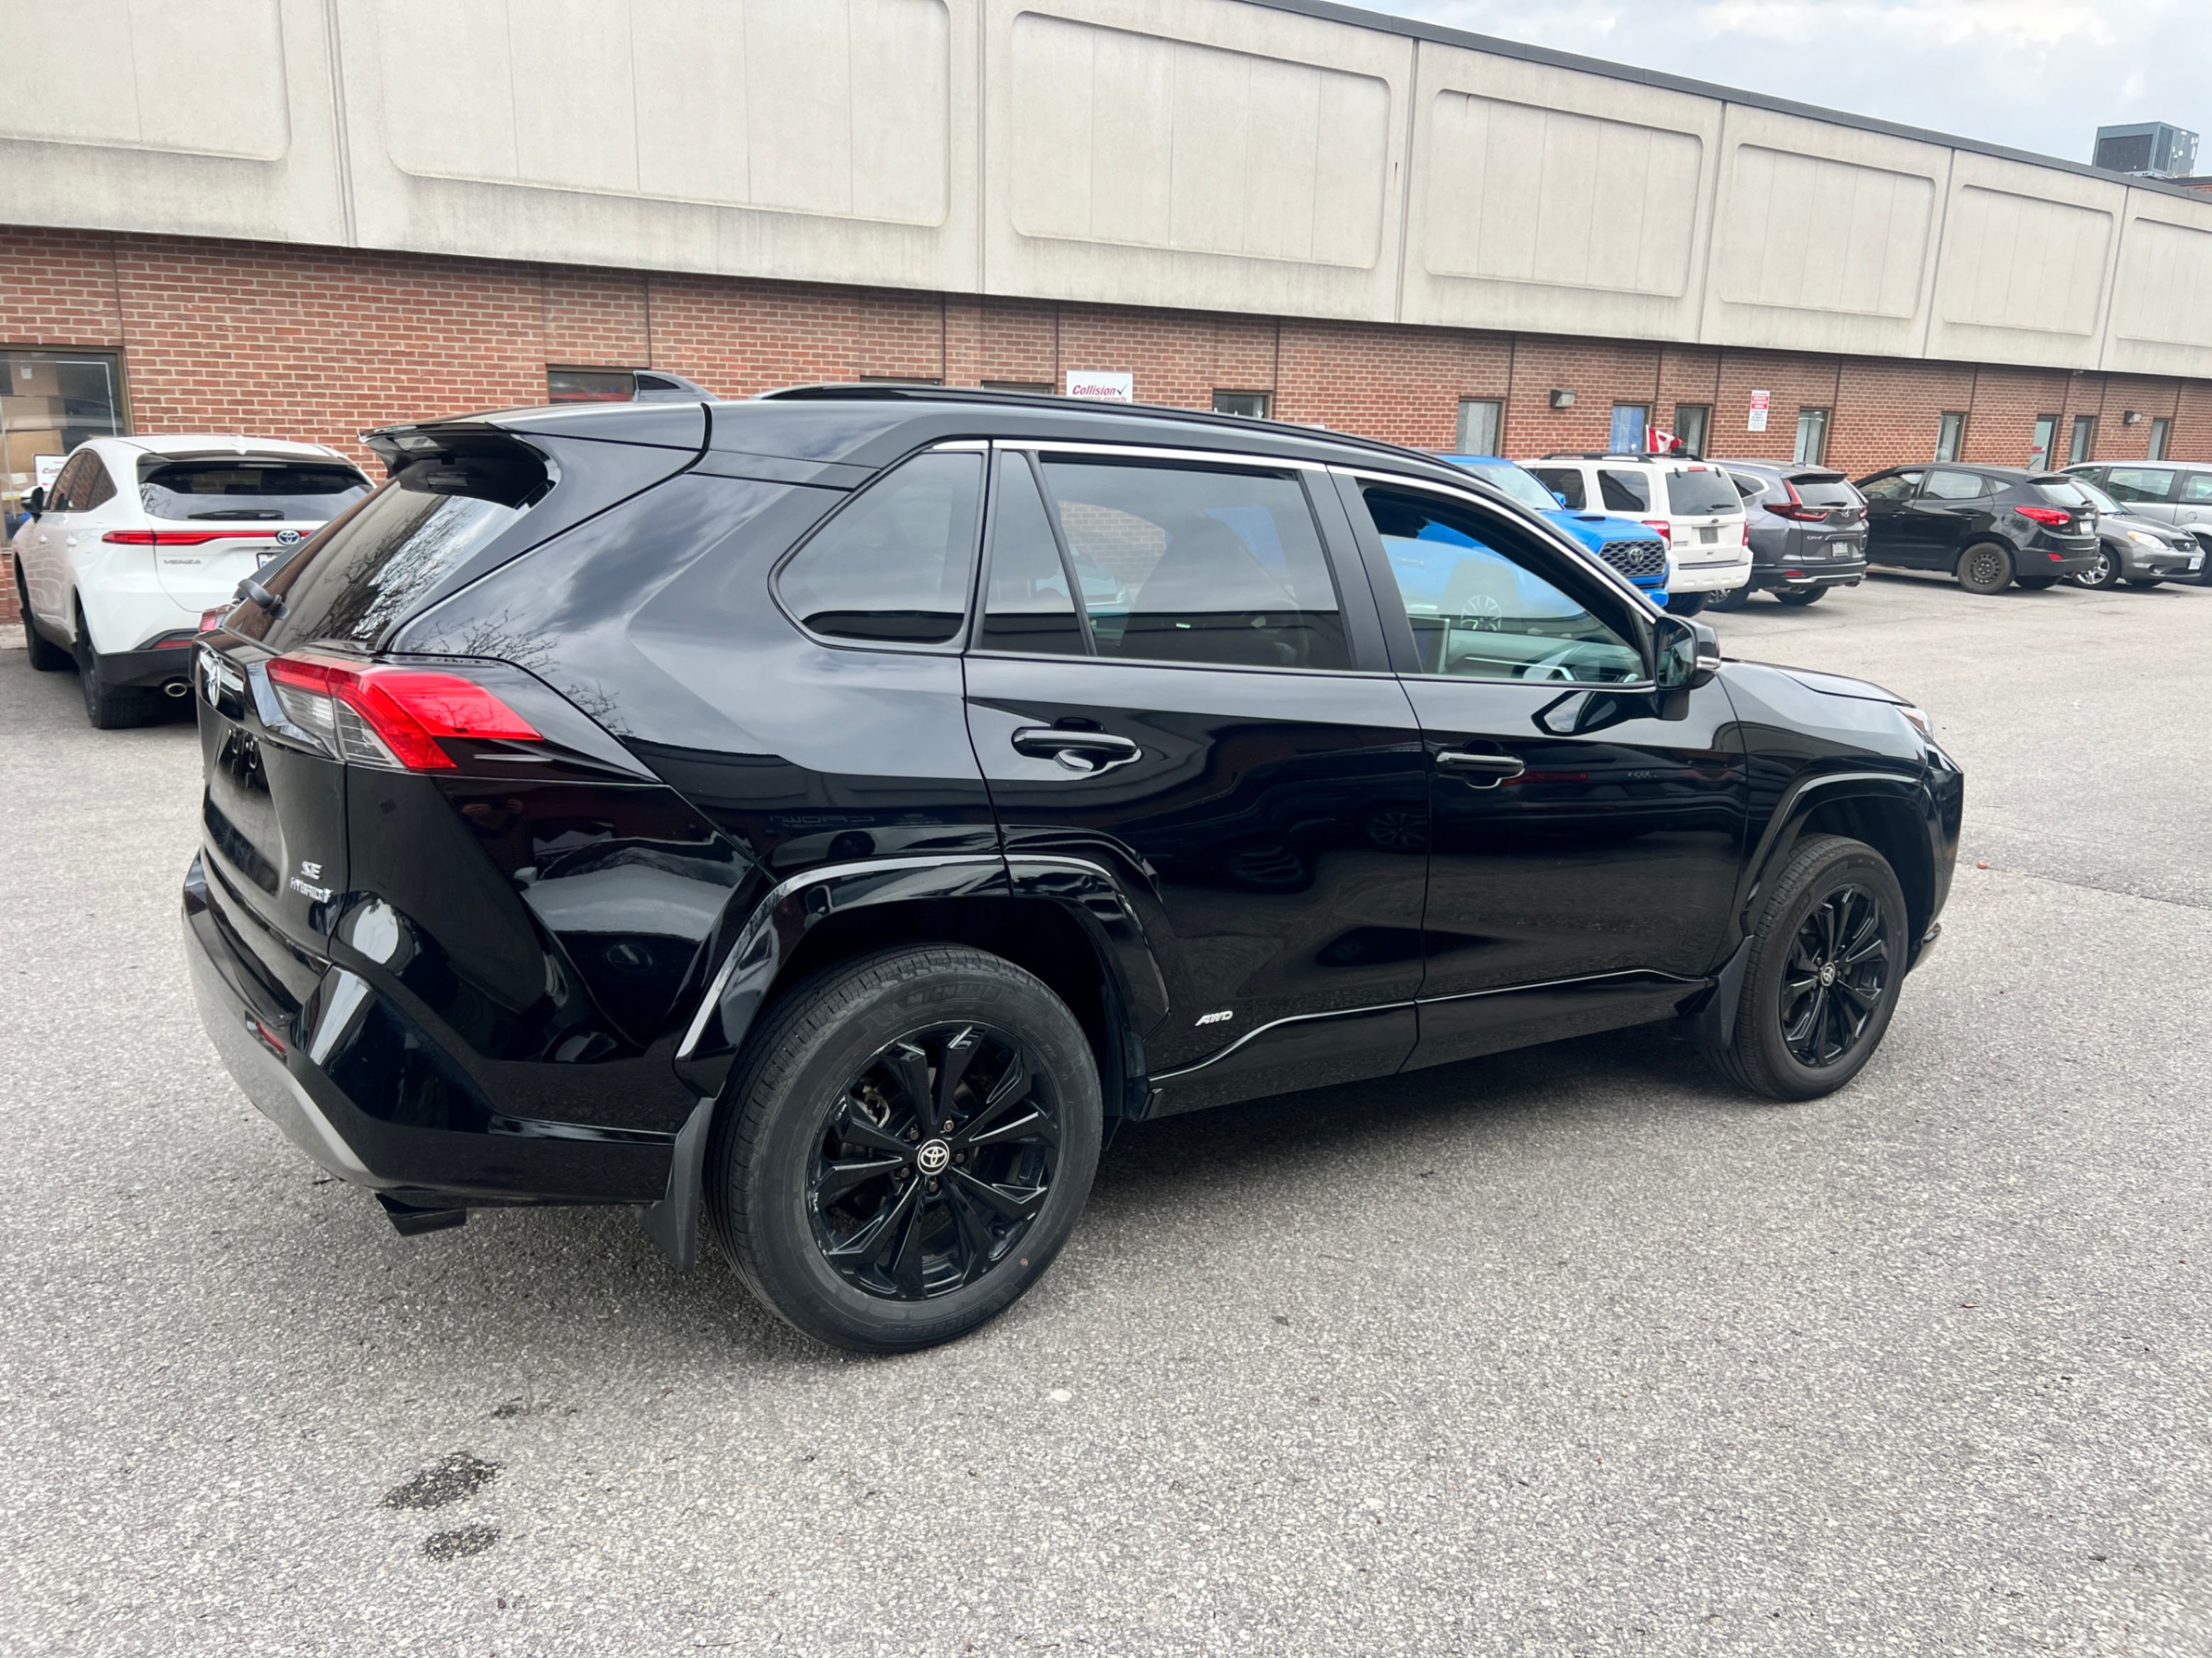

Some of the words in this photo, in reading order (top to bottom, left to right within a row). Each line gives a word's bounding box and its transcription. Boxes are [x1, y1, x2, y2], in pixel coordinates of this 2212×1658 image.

[1072, 385, 1116, 395] Collision
[301, 861, 323, 880] SE
[290, 877, 323, 901] HYBRID
[1195, 1010, 1233, 1027] AWD
